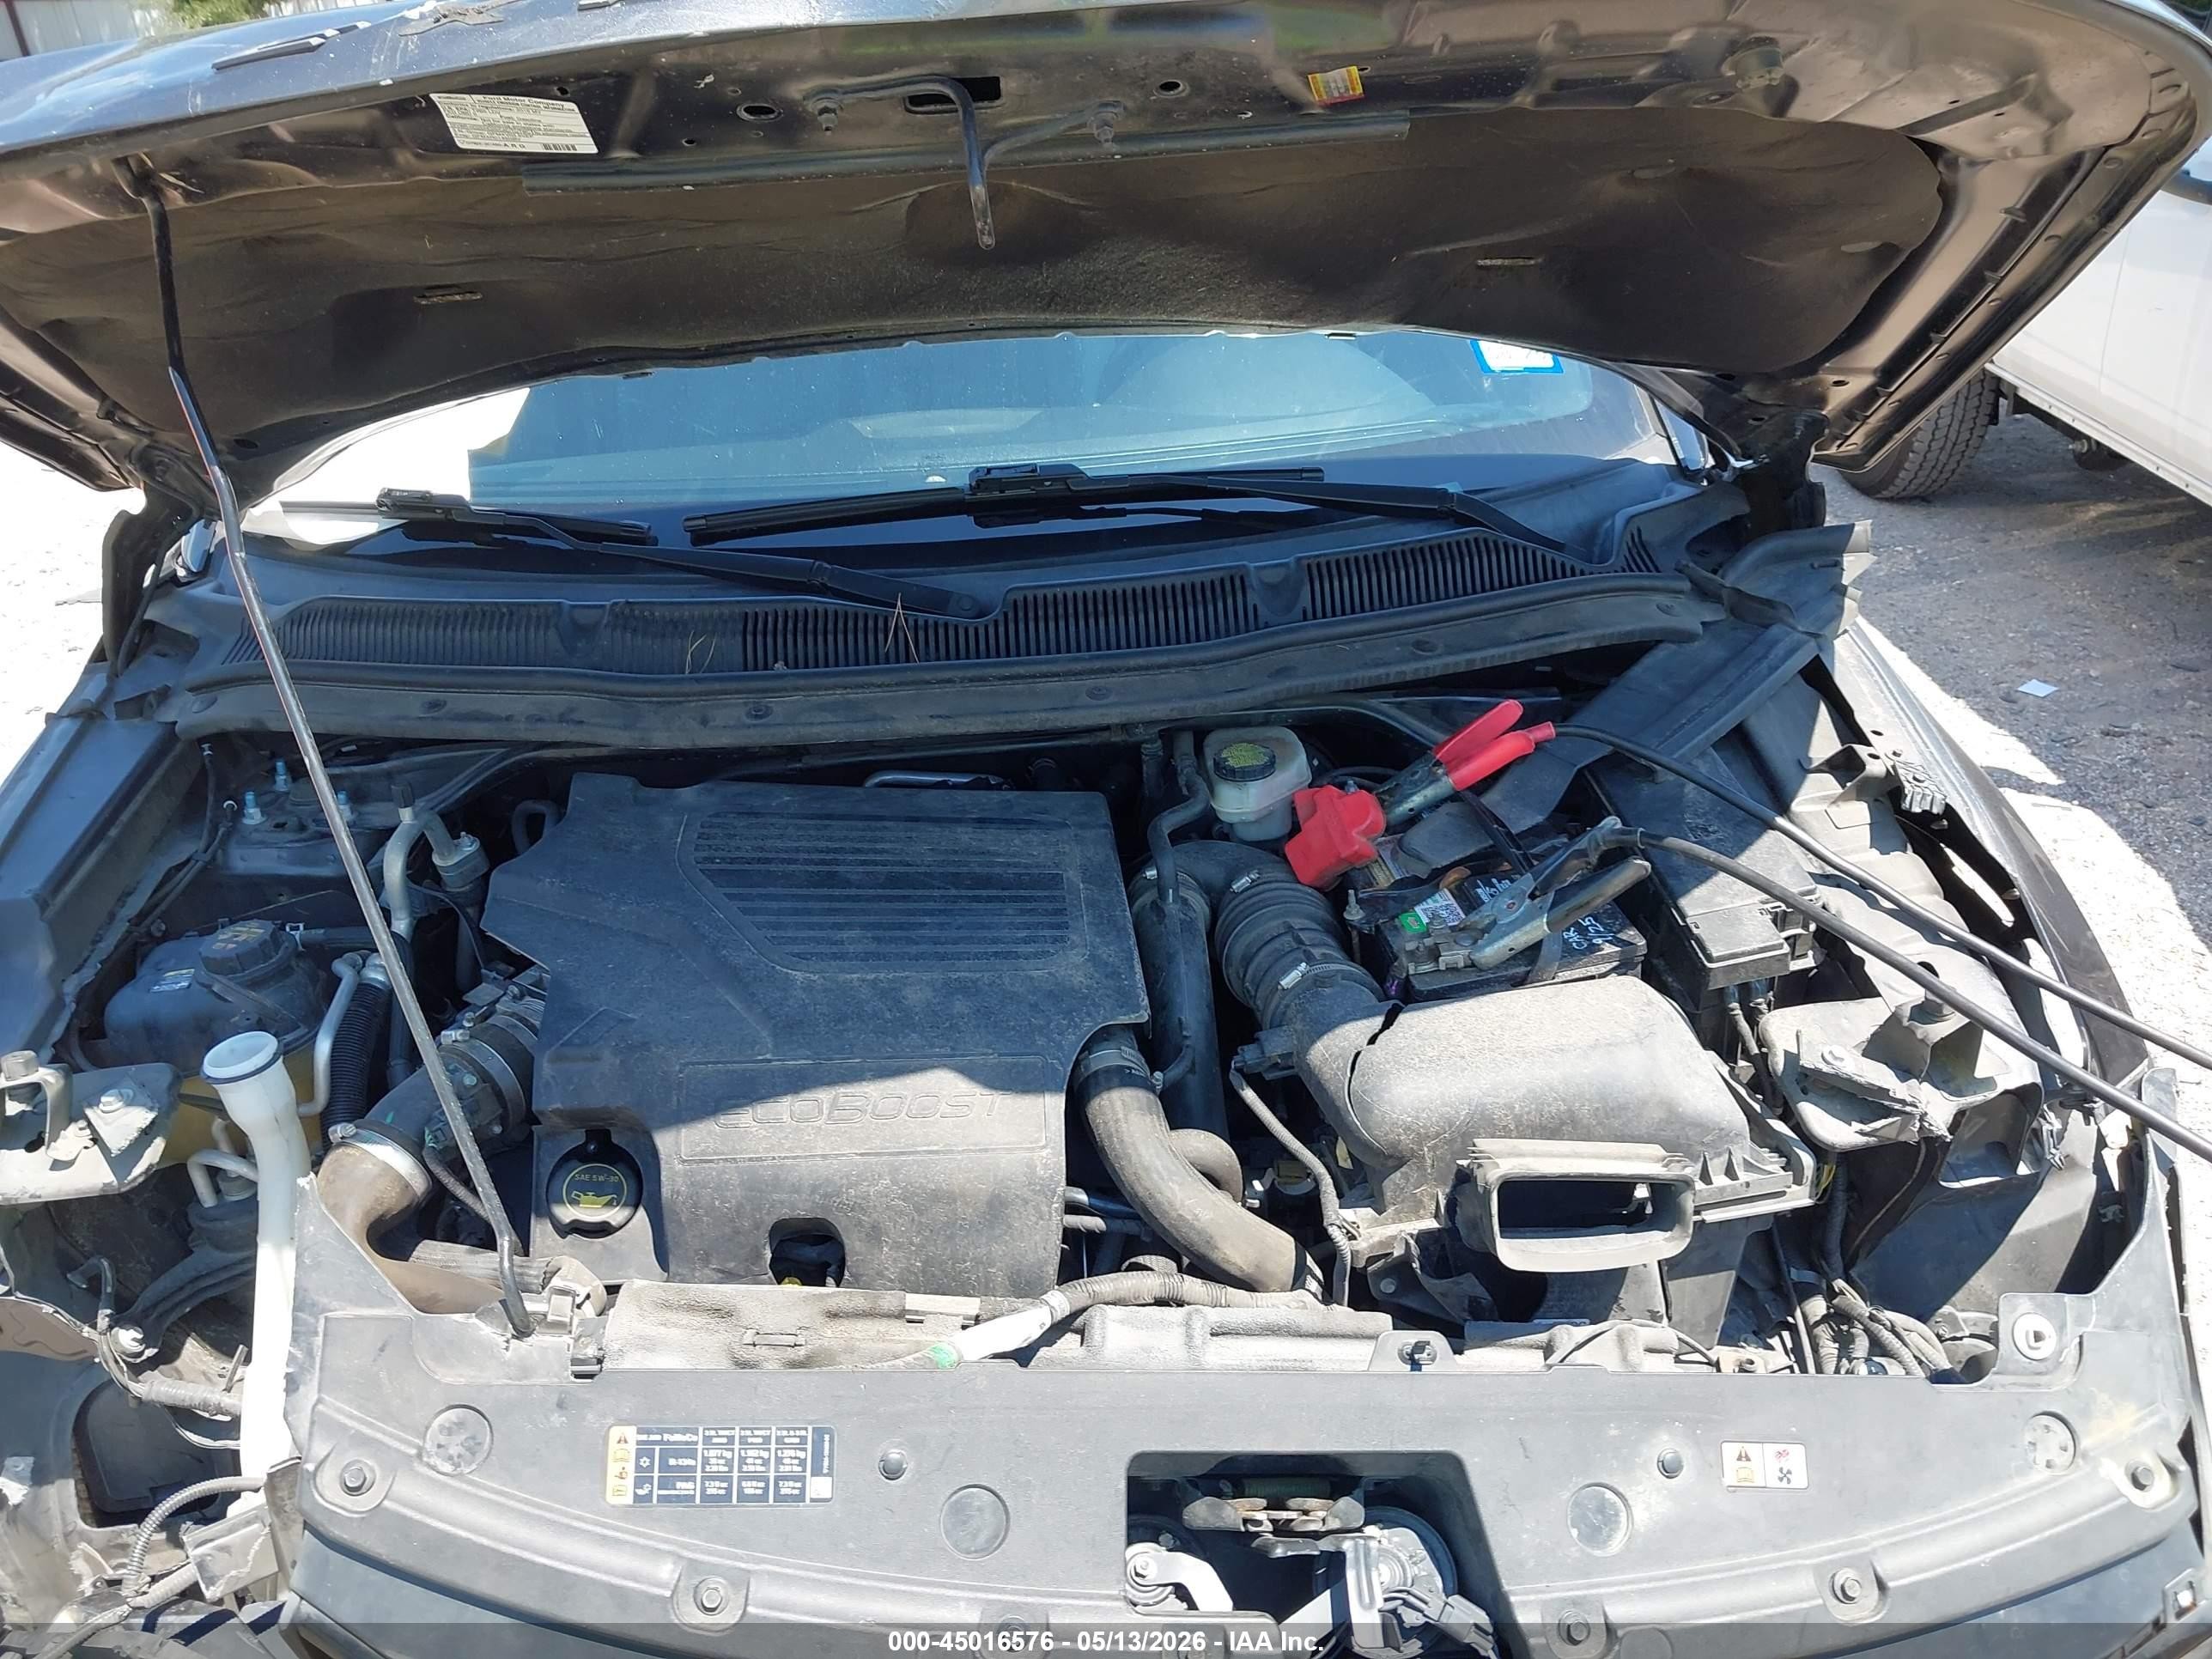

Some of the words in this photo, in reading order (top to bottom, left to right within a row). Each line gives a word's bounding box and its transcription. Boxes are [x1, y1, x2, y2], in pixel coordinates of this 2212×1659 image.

[528, 98, 564, 109] Company
[1563, 927, 1587, 949] CAR
[1577, 916, 1614, 944] 9/25
[592, 1174, 619, 1182] 5W-30
